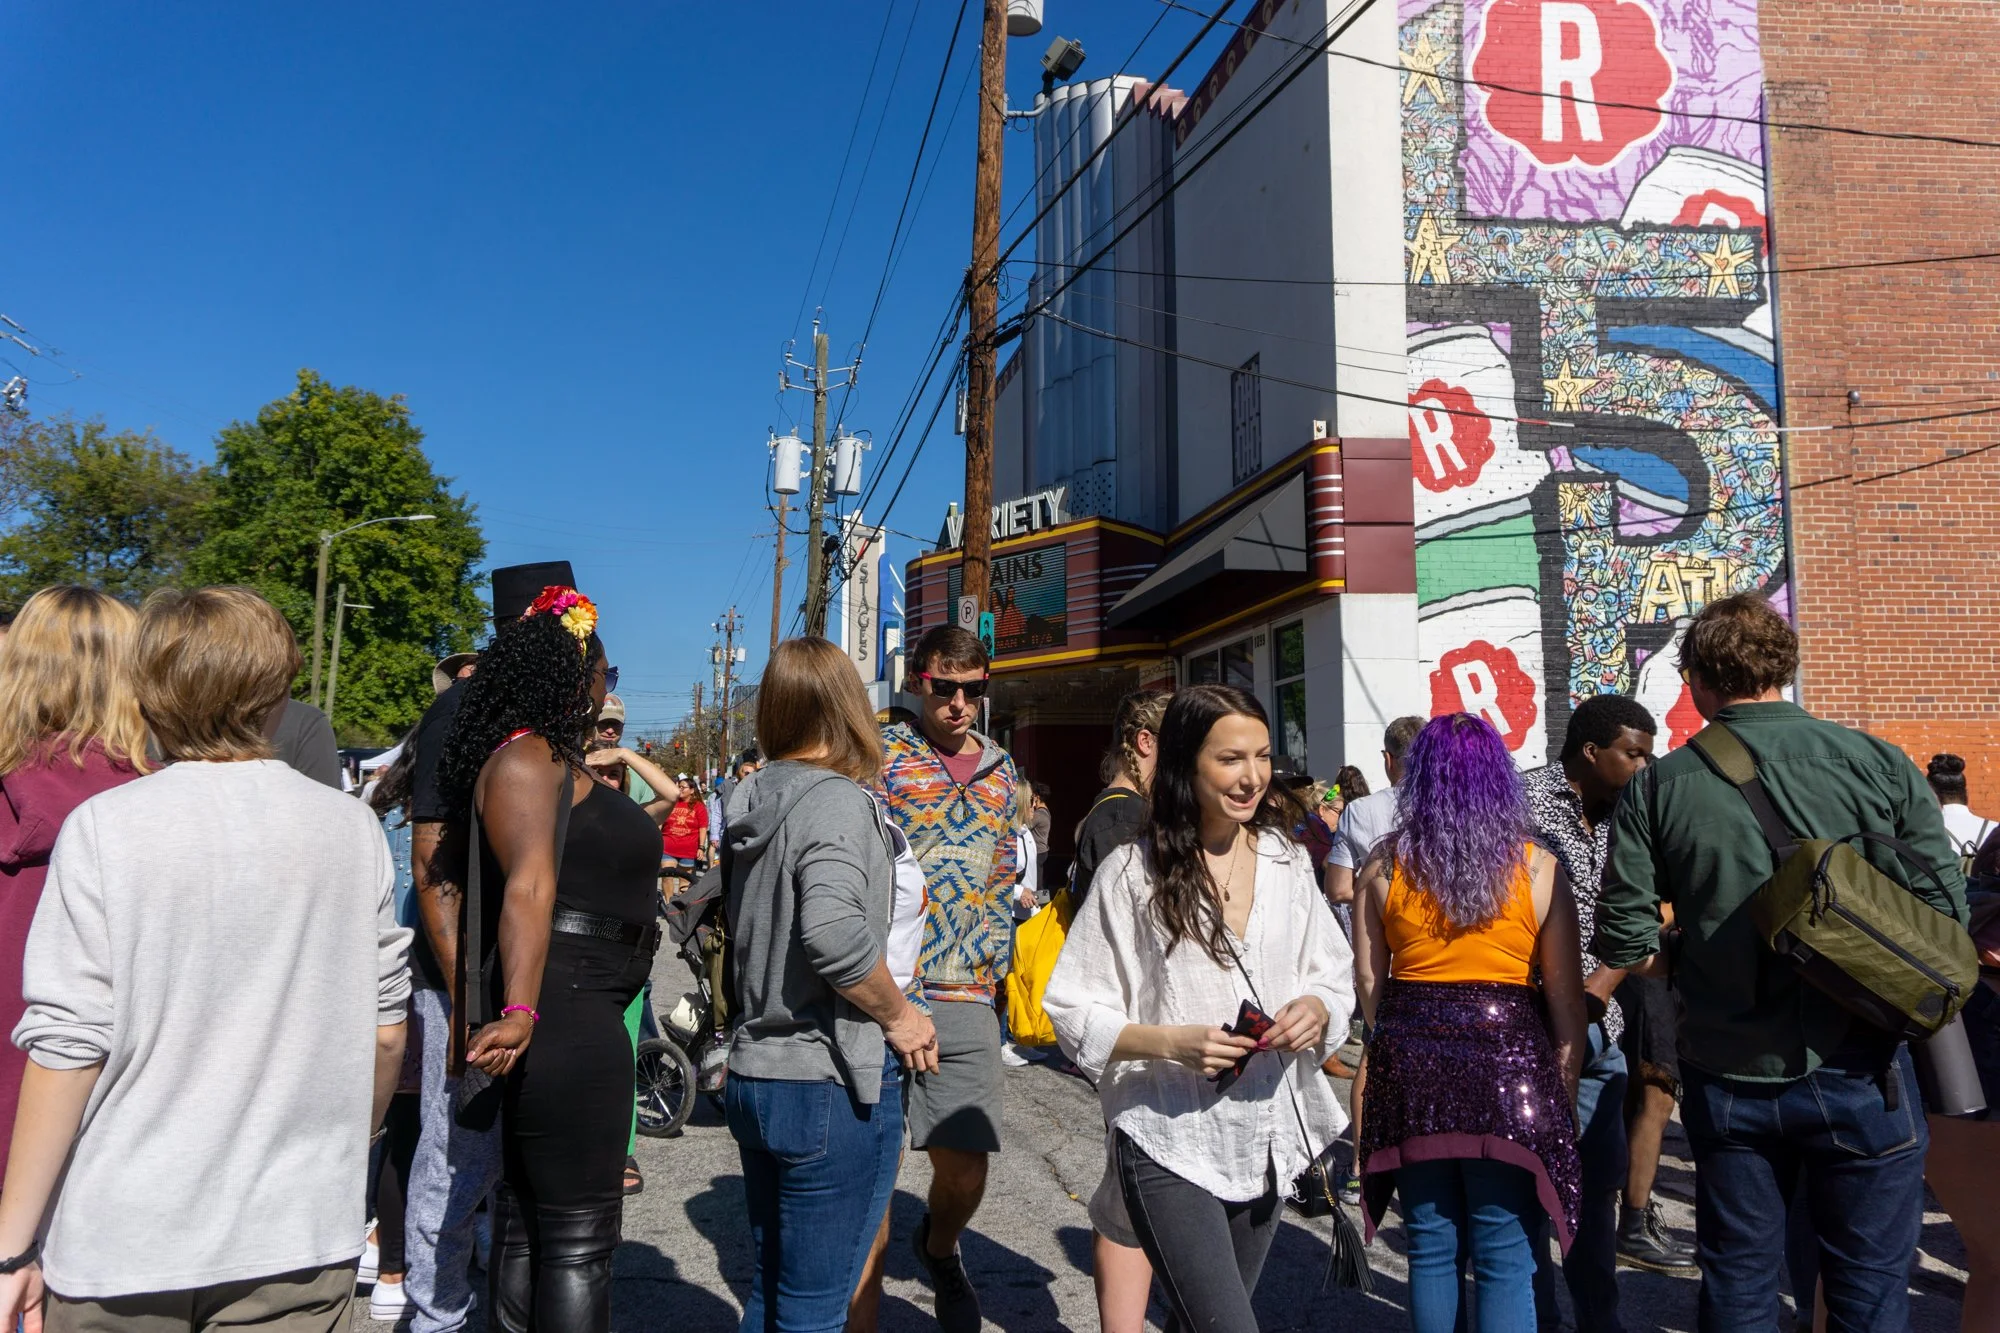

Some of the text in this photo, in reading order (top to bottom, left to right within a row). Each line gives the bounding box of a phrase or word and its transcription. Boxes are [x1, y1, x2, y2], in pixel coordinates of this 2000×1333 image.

[1540, 2, 1603, 142] R
[1408, 397, 1468, 480] R
[947, 486, 1066, 549] VRIETY
[857, 563, 870, 661] STAGES
[990, 553, 1043, 588] AINS
